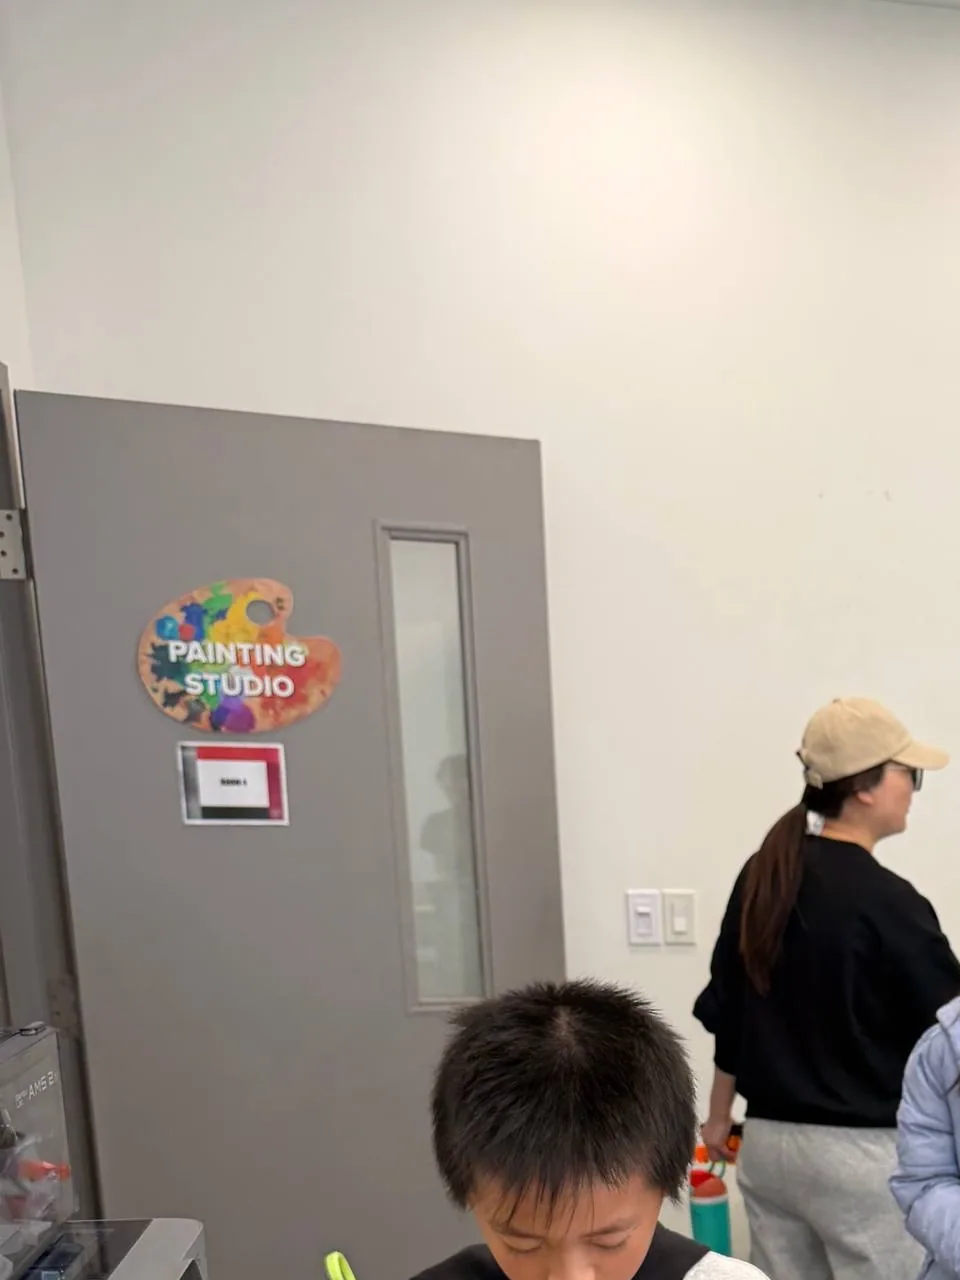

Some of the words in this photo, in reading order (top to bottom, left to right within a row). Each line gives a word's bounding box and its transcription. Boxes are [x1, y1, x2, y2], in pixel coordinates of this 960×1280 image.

[168, 639, 308, 667] PAINTING
[184, 672, 295, 697] STUDIO
[28, 1075, 48, 1100] AMS
